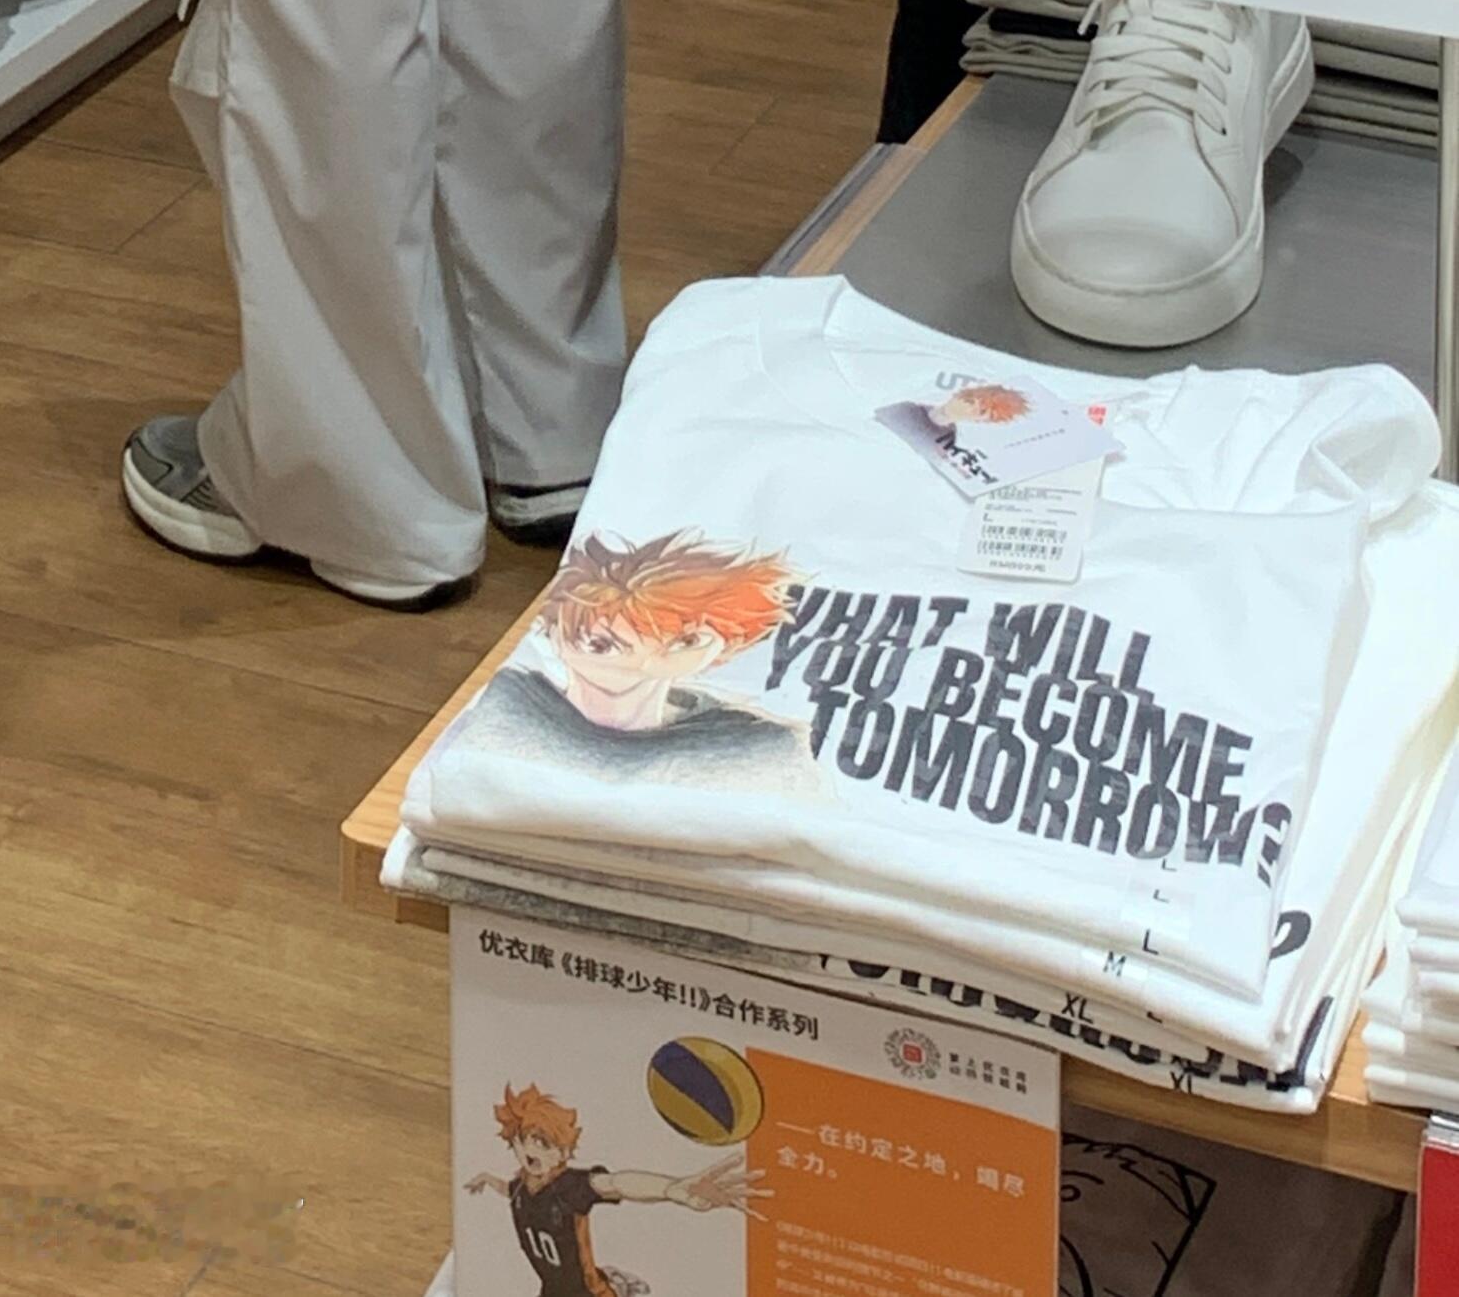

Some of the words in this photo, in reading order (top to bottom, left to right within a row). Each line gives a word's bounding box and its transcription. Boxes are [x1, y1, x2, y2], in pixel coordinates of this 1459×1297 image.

[984, 602, 1154, 700] WILL
[765, 636, 914, 699] YOU
[915, 646, 1254, 812] BECOME
[1143, 928, 1159, 955] L
[1102, 950, 1127, 977] M
[1061, 991, 1094, 1024] XL
[777, 1145, 838, 1180] 全力。
[526, 1226, 561, 1267] 10
